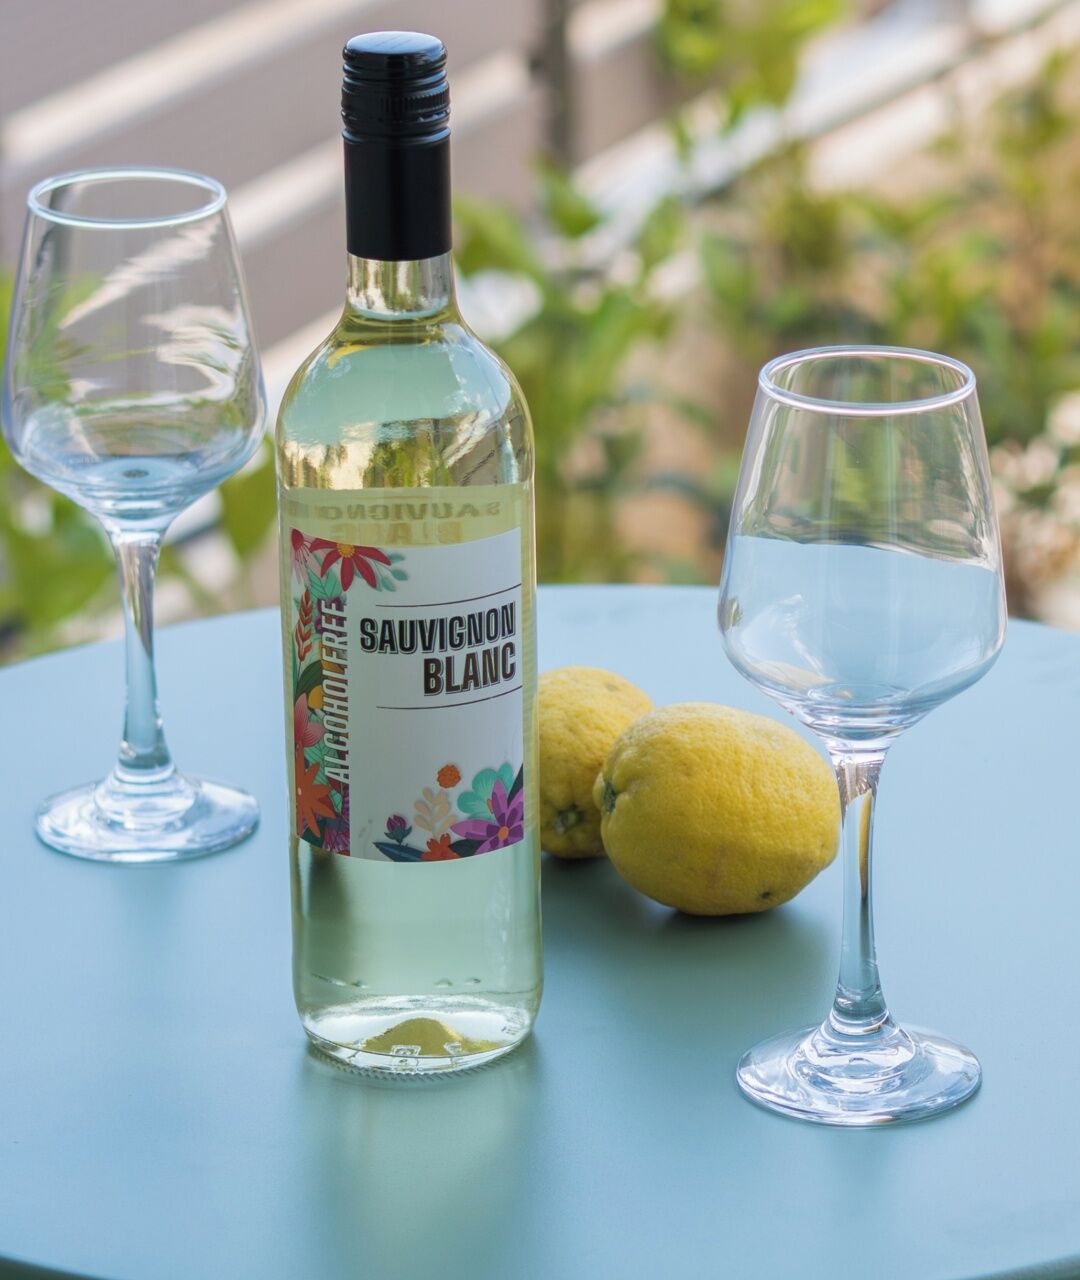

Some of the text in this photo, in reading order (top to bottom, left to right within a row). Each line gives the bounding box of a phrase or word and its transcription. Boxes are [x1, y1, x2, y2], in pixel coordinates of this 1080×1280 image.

[359, 601, 516, 654] SAUVIGNON
[321, 600, 350, 785] ALCOHOLFREE
[423, 642, 517, 697] BLANC
